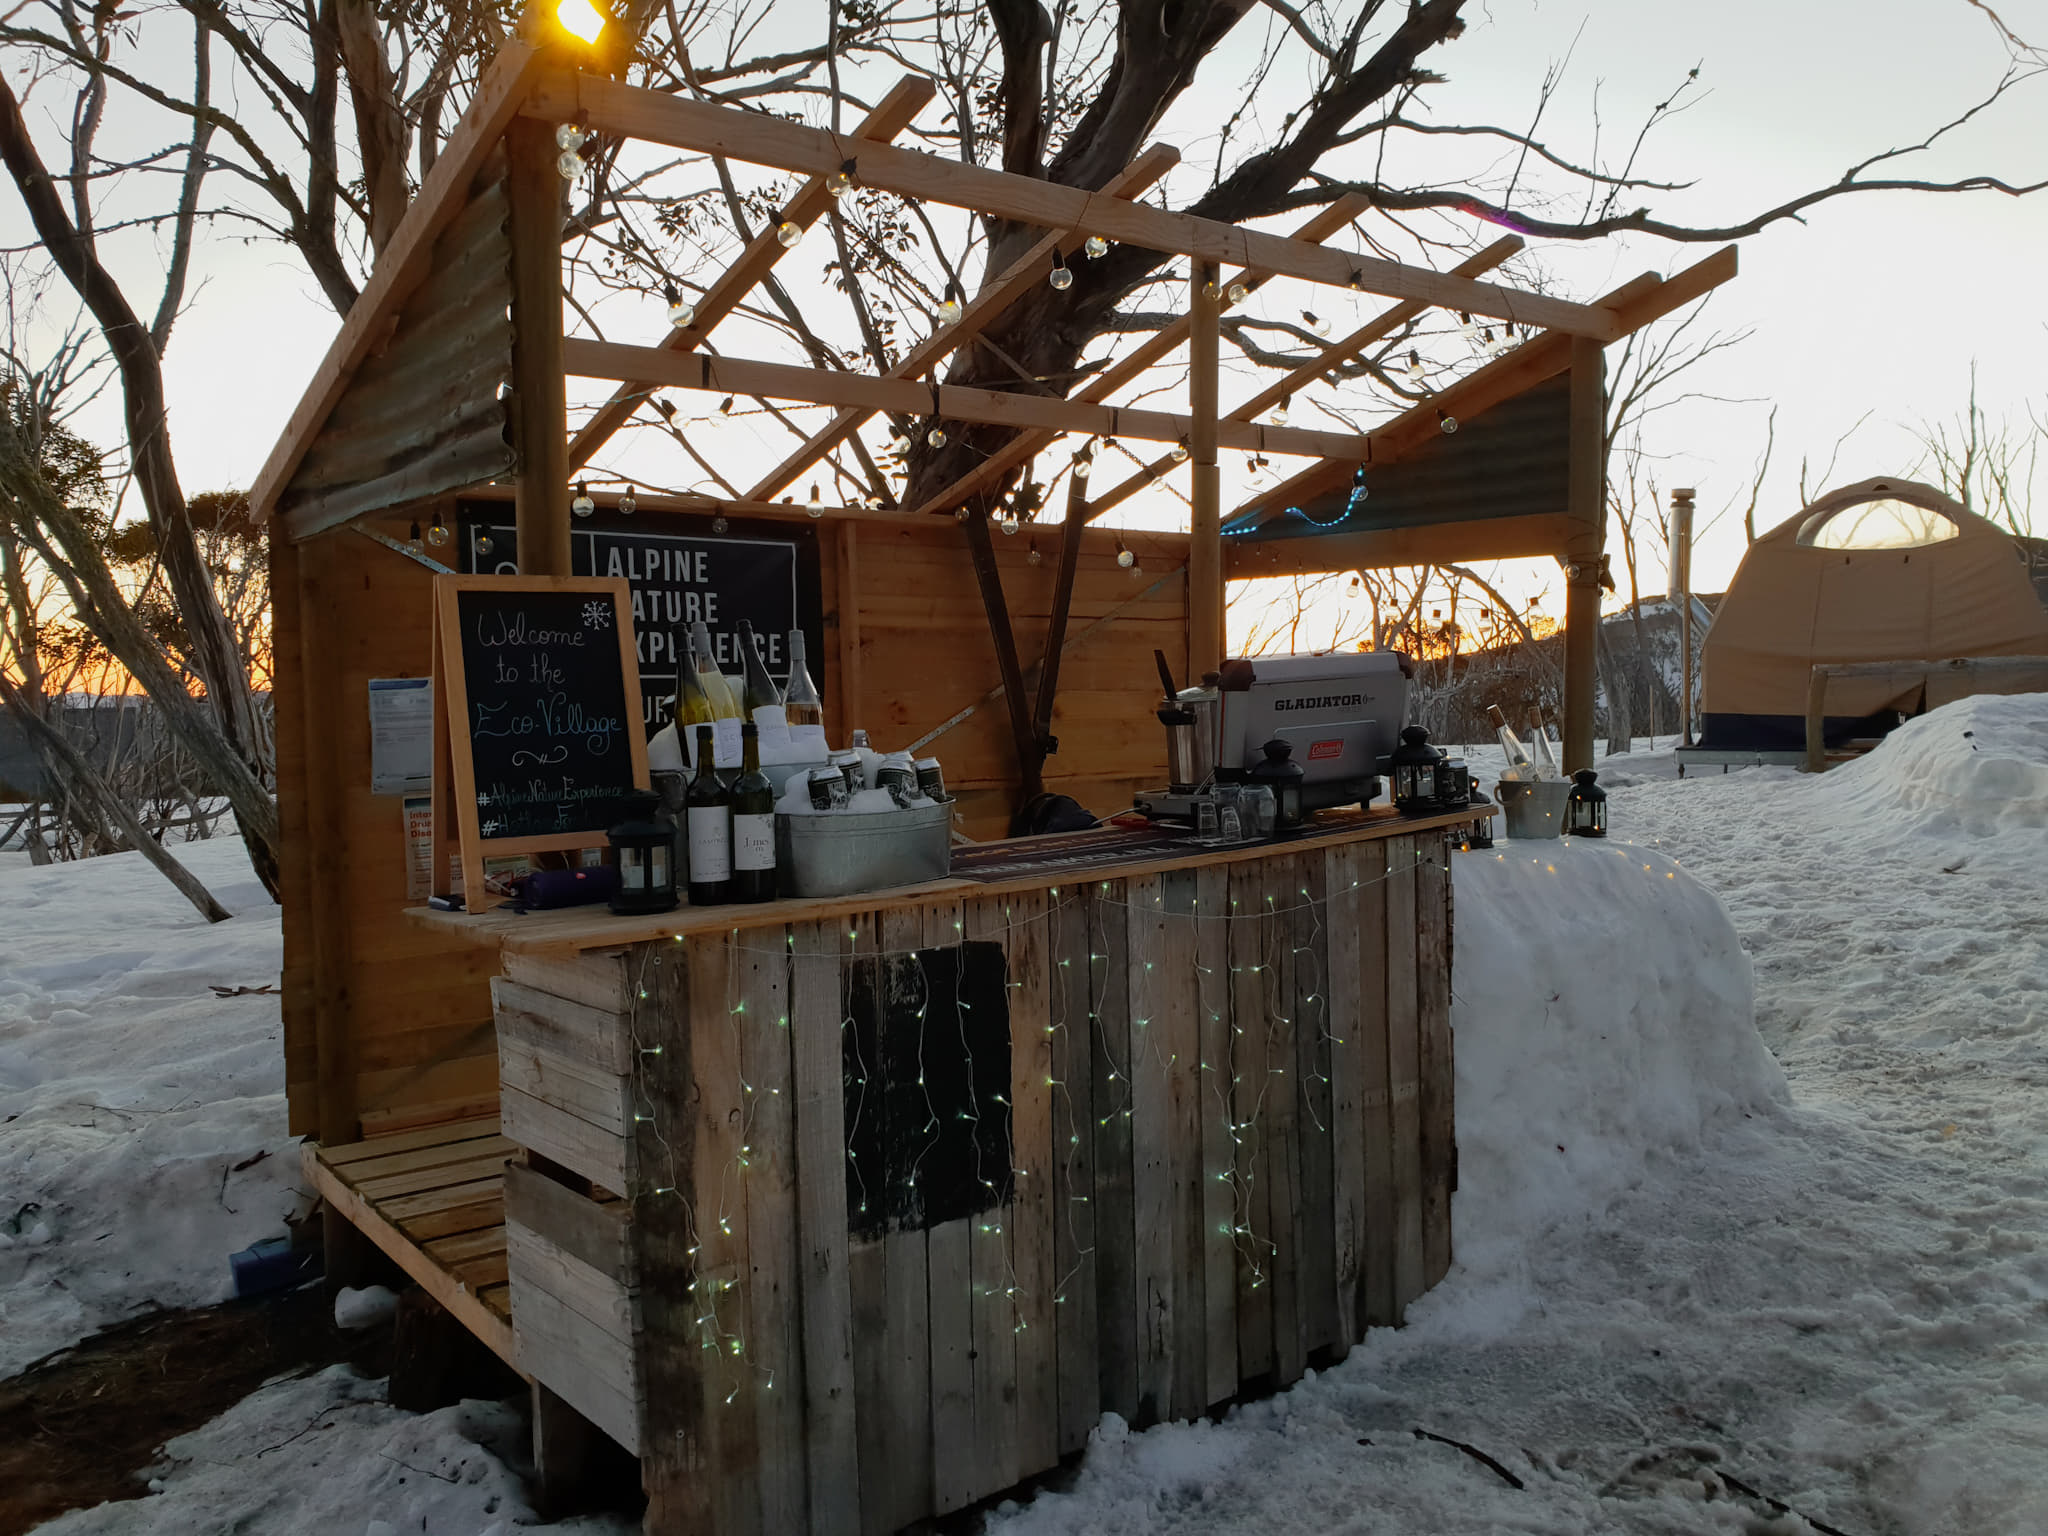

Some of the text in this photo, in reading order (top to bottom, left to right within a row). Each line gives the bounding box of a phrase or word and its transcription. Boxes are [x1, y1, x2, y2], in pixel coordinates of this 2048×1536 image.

[607, 547, 709, 583] ALPINE
[632, 590, 719, 624] ATURE
[478, 610, 585, 647] Welcome
[495, 652, 566, 692] to the
[1275, 694, 1361, 711] GLADIATOR
[474, 691, 622, 755] Eco-Village
